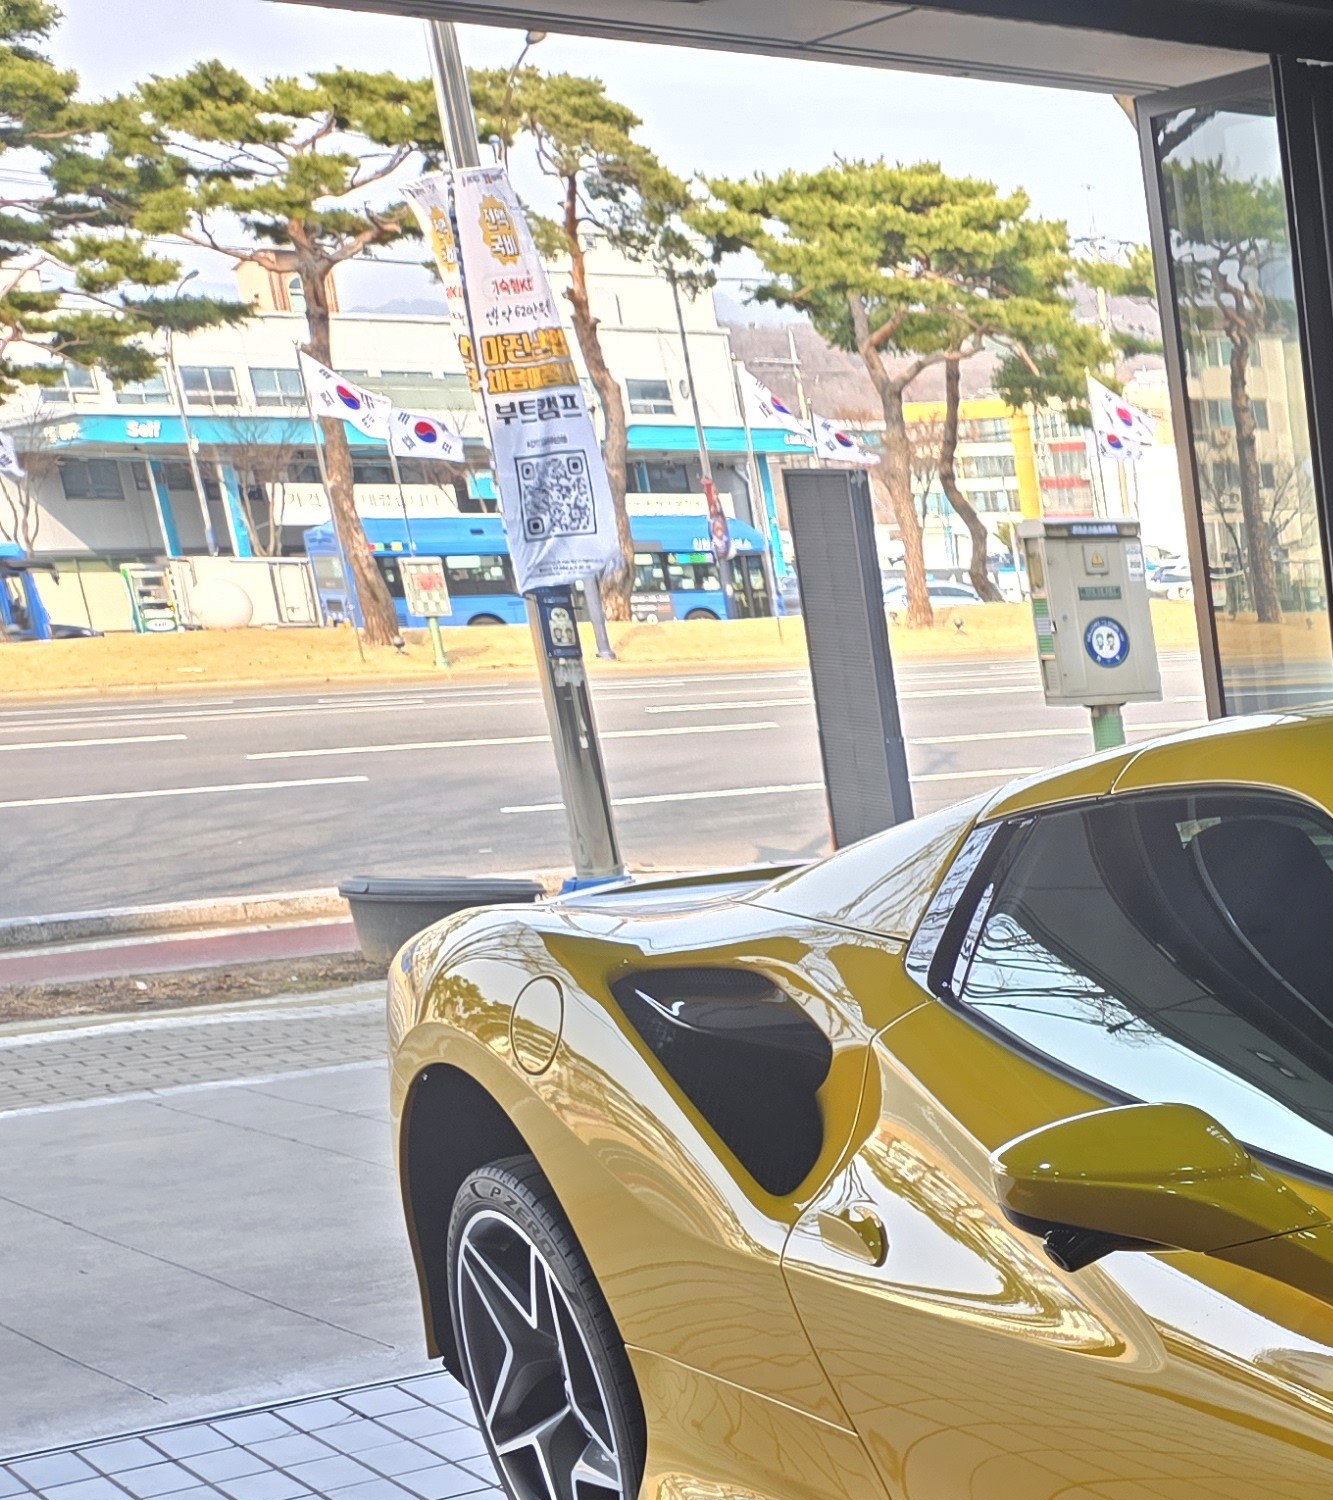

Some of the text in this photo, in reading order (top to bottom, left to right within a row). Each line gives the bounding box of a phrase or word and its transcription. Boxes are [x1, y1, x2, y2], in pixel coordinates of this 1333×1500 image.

[495, 394, 583, 425] 부트캠프
[126, 420, 161, 439] Self
[490, 1186, 556, 1258] P ZERO
